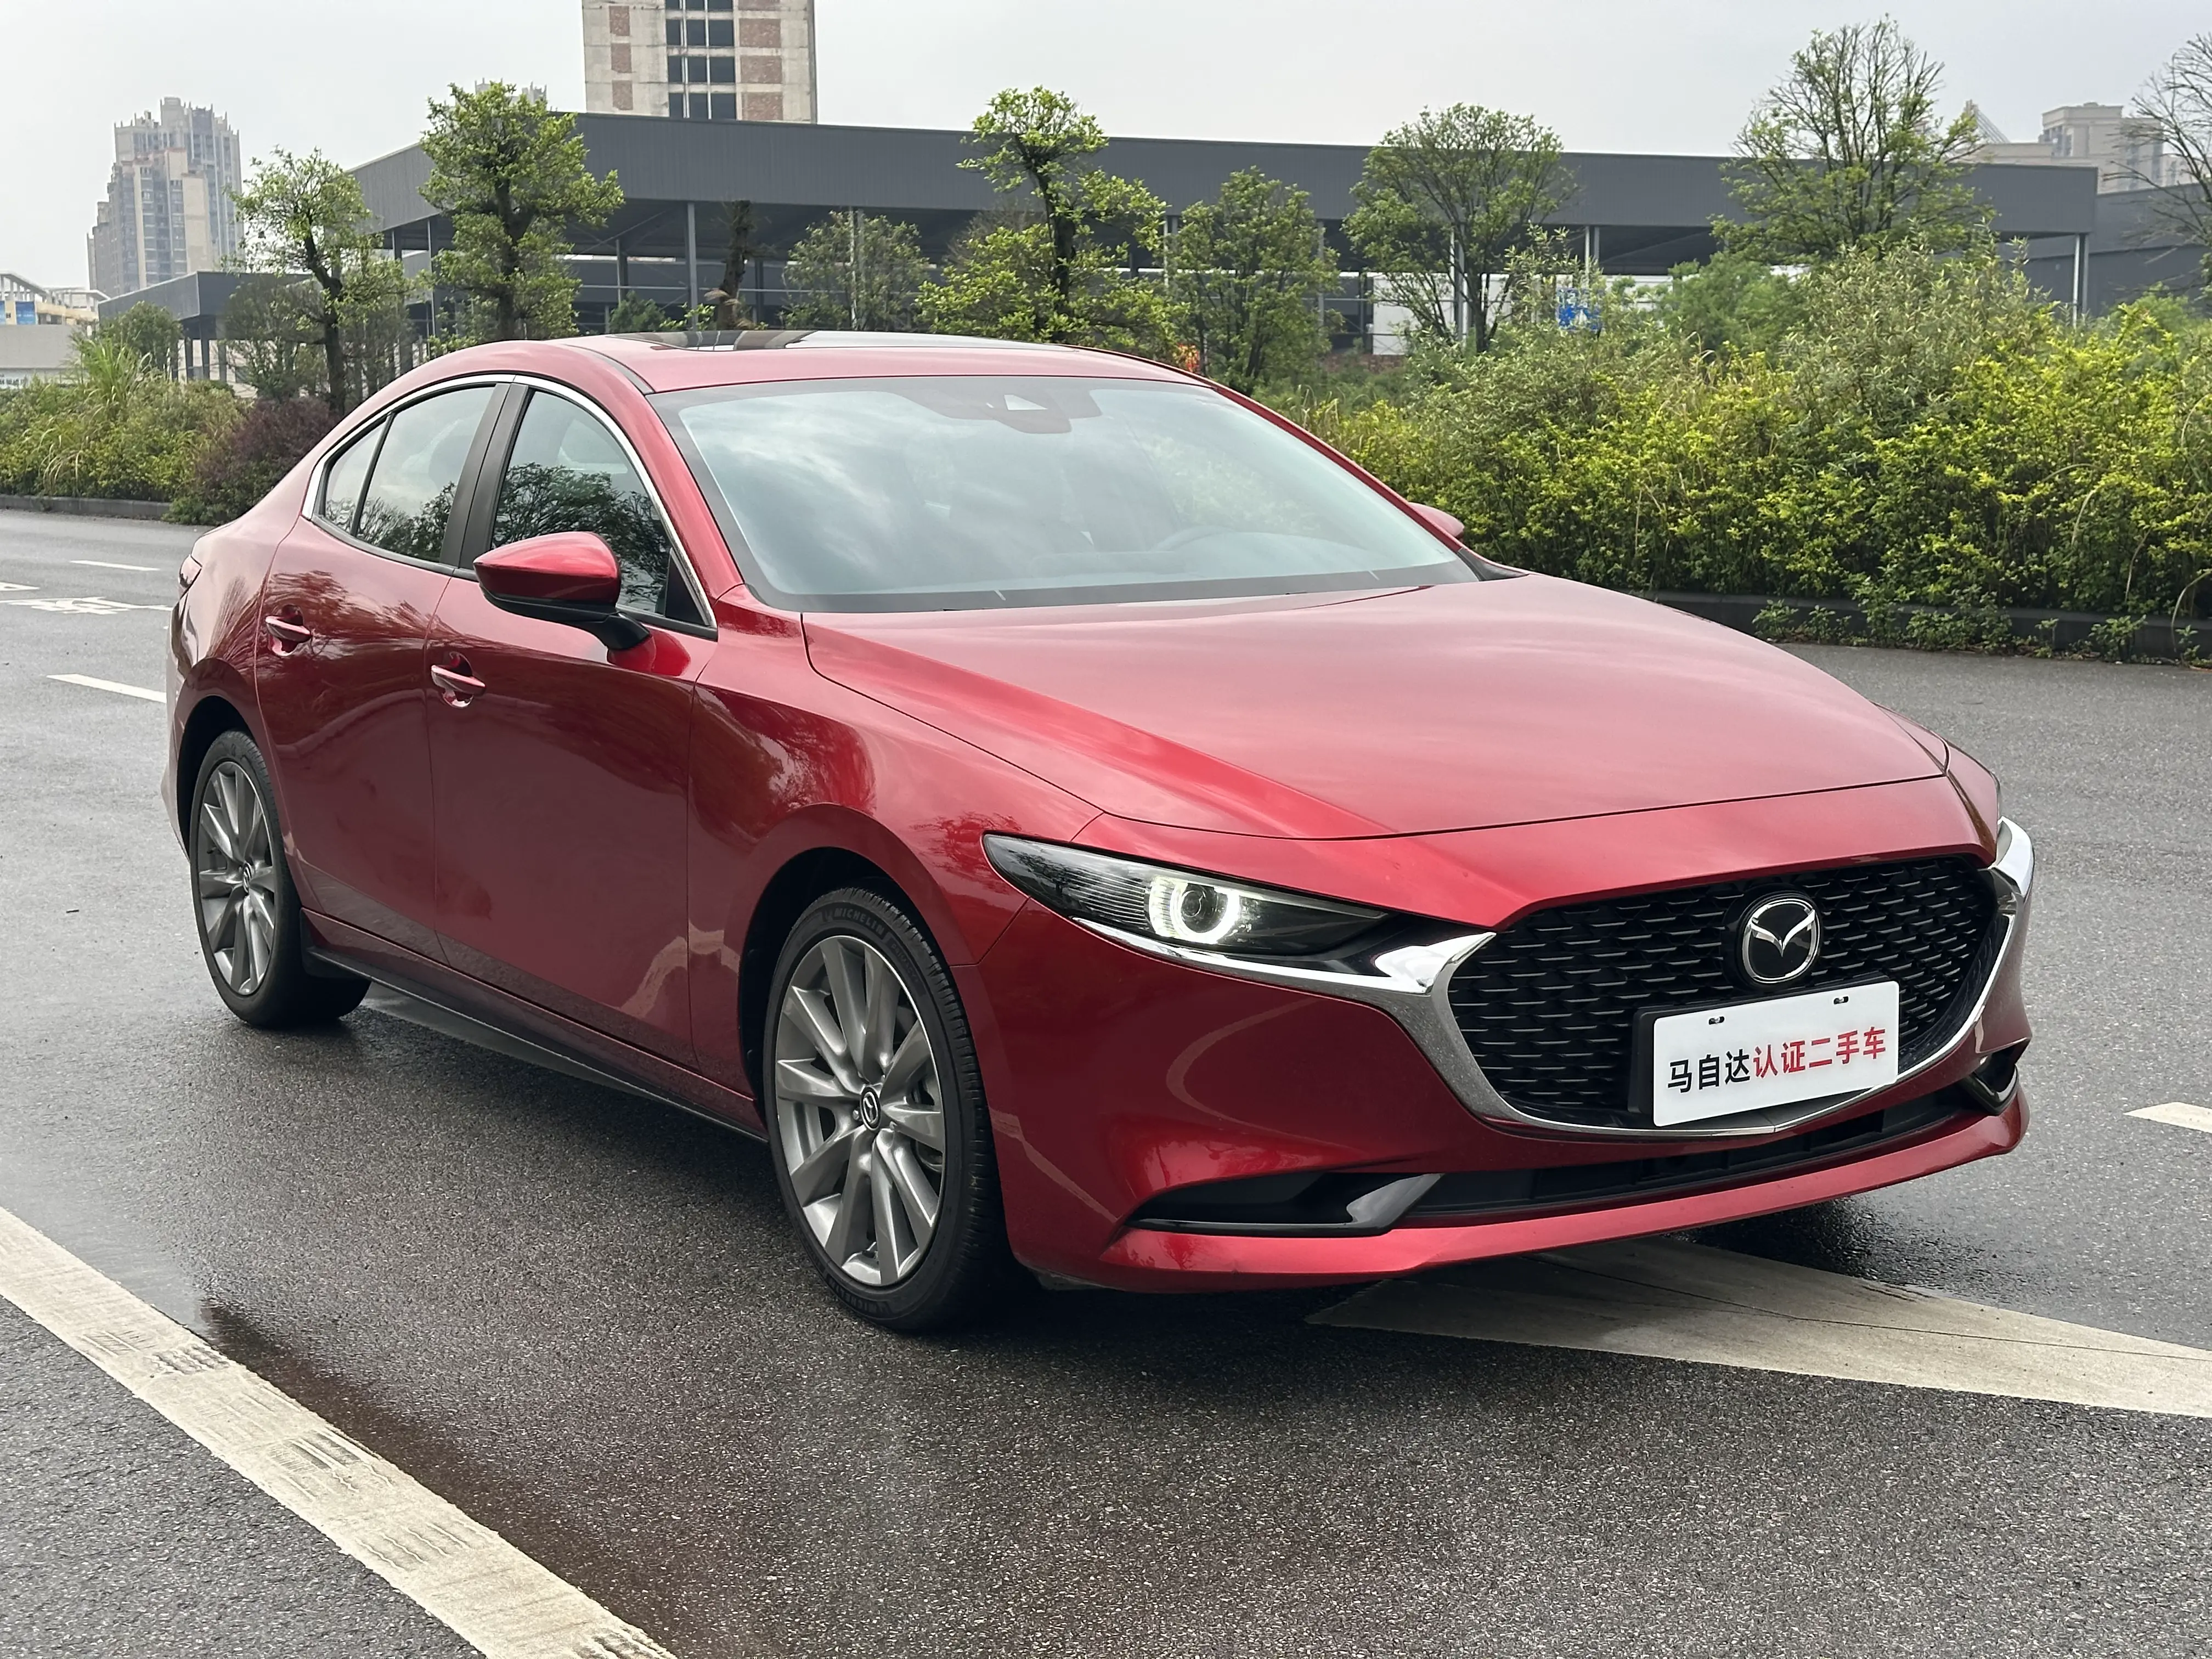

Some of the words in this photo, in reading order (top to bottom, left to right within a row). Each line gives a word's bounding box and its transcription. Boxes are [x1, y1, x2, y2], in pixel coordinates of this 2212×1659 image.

[833, 907, 885, 936] MICHELIN
[1667, 1026, 1886, 1093] 马自达认证二手车
